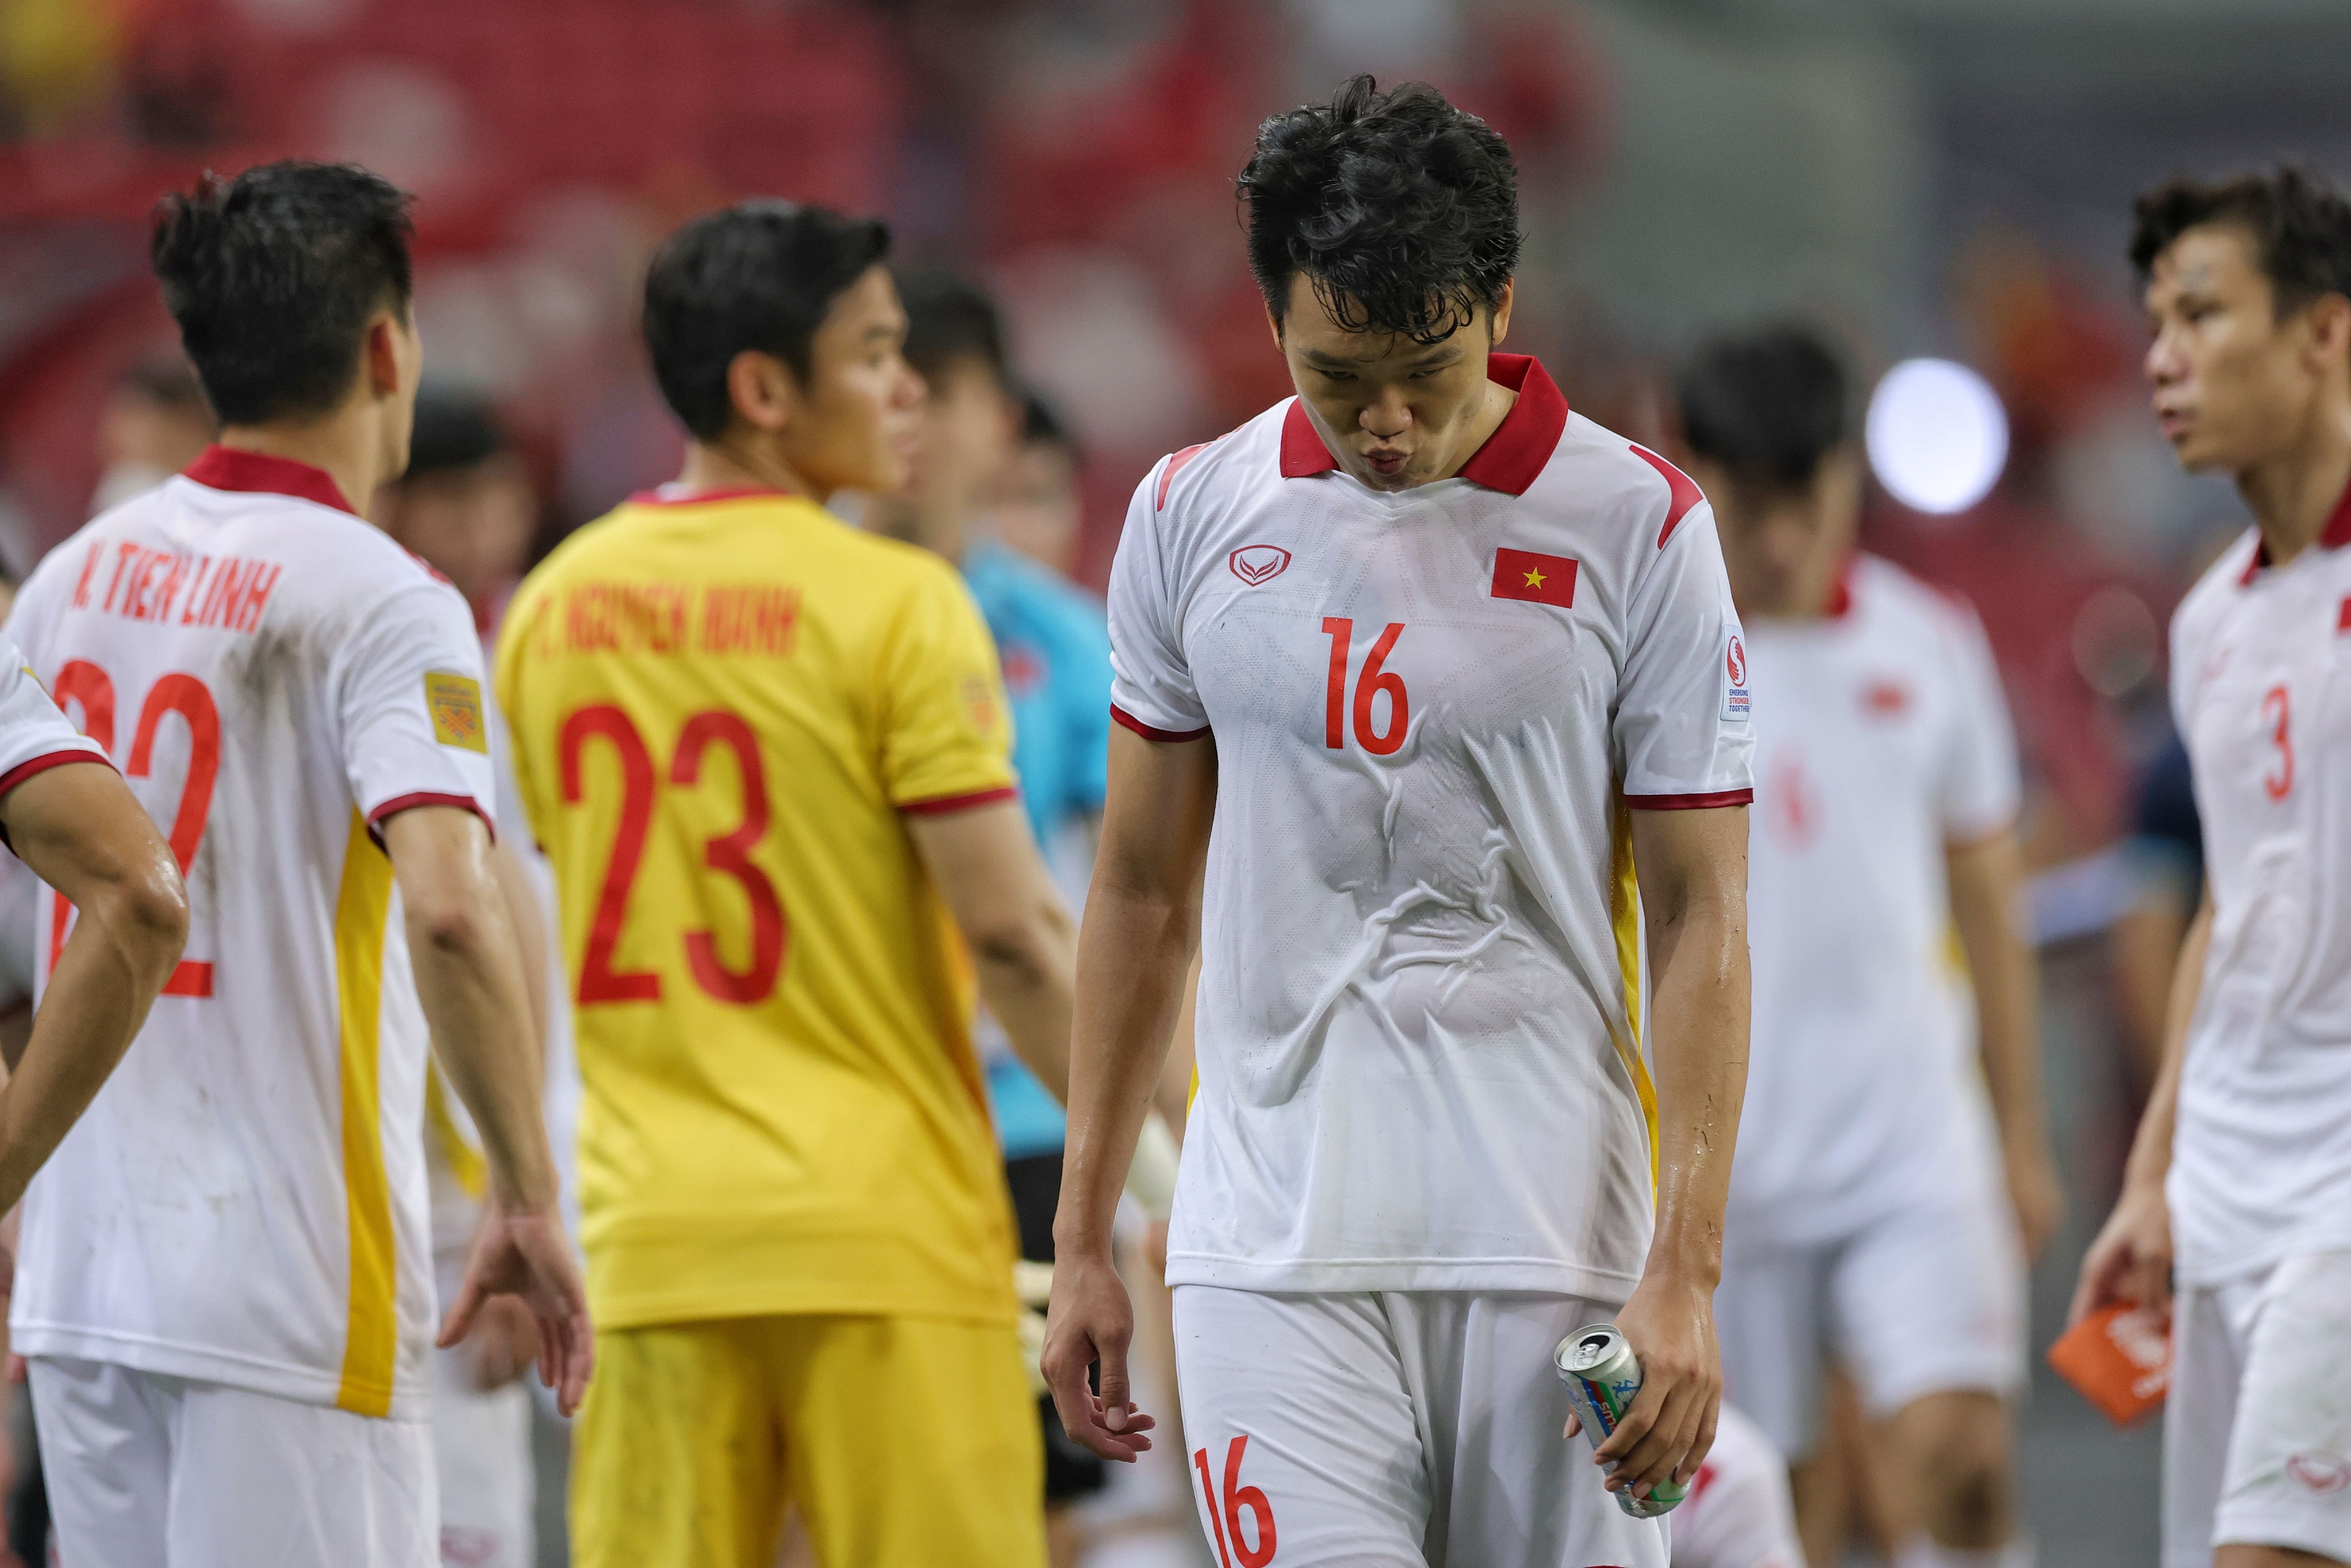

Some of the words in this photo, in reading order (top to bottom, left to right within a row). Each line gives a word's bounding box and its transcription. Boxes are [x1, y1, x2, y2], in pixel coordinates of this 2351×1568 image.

[180, 554, 283, 635] LINH
[1321, 617, 1408, 755] 16
[2261, 684, 2294, 804] 3
[558, 704, 786, 1006] 23
[1194, 1435, 1277, 1568] 16
